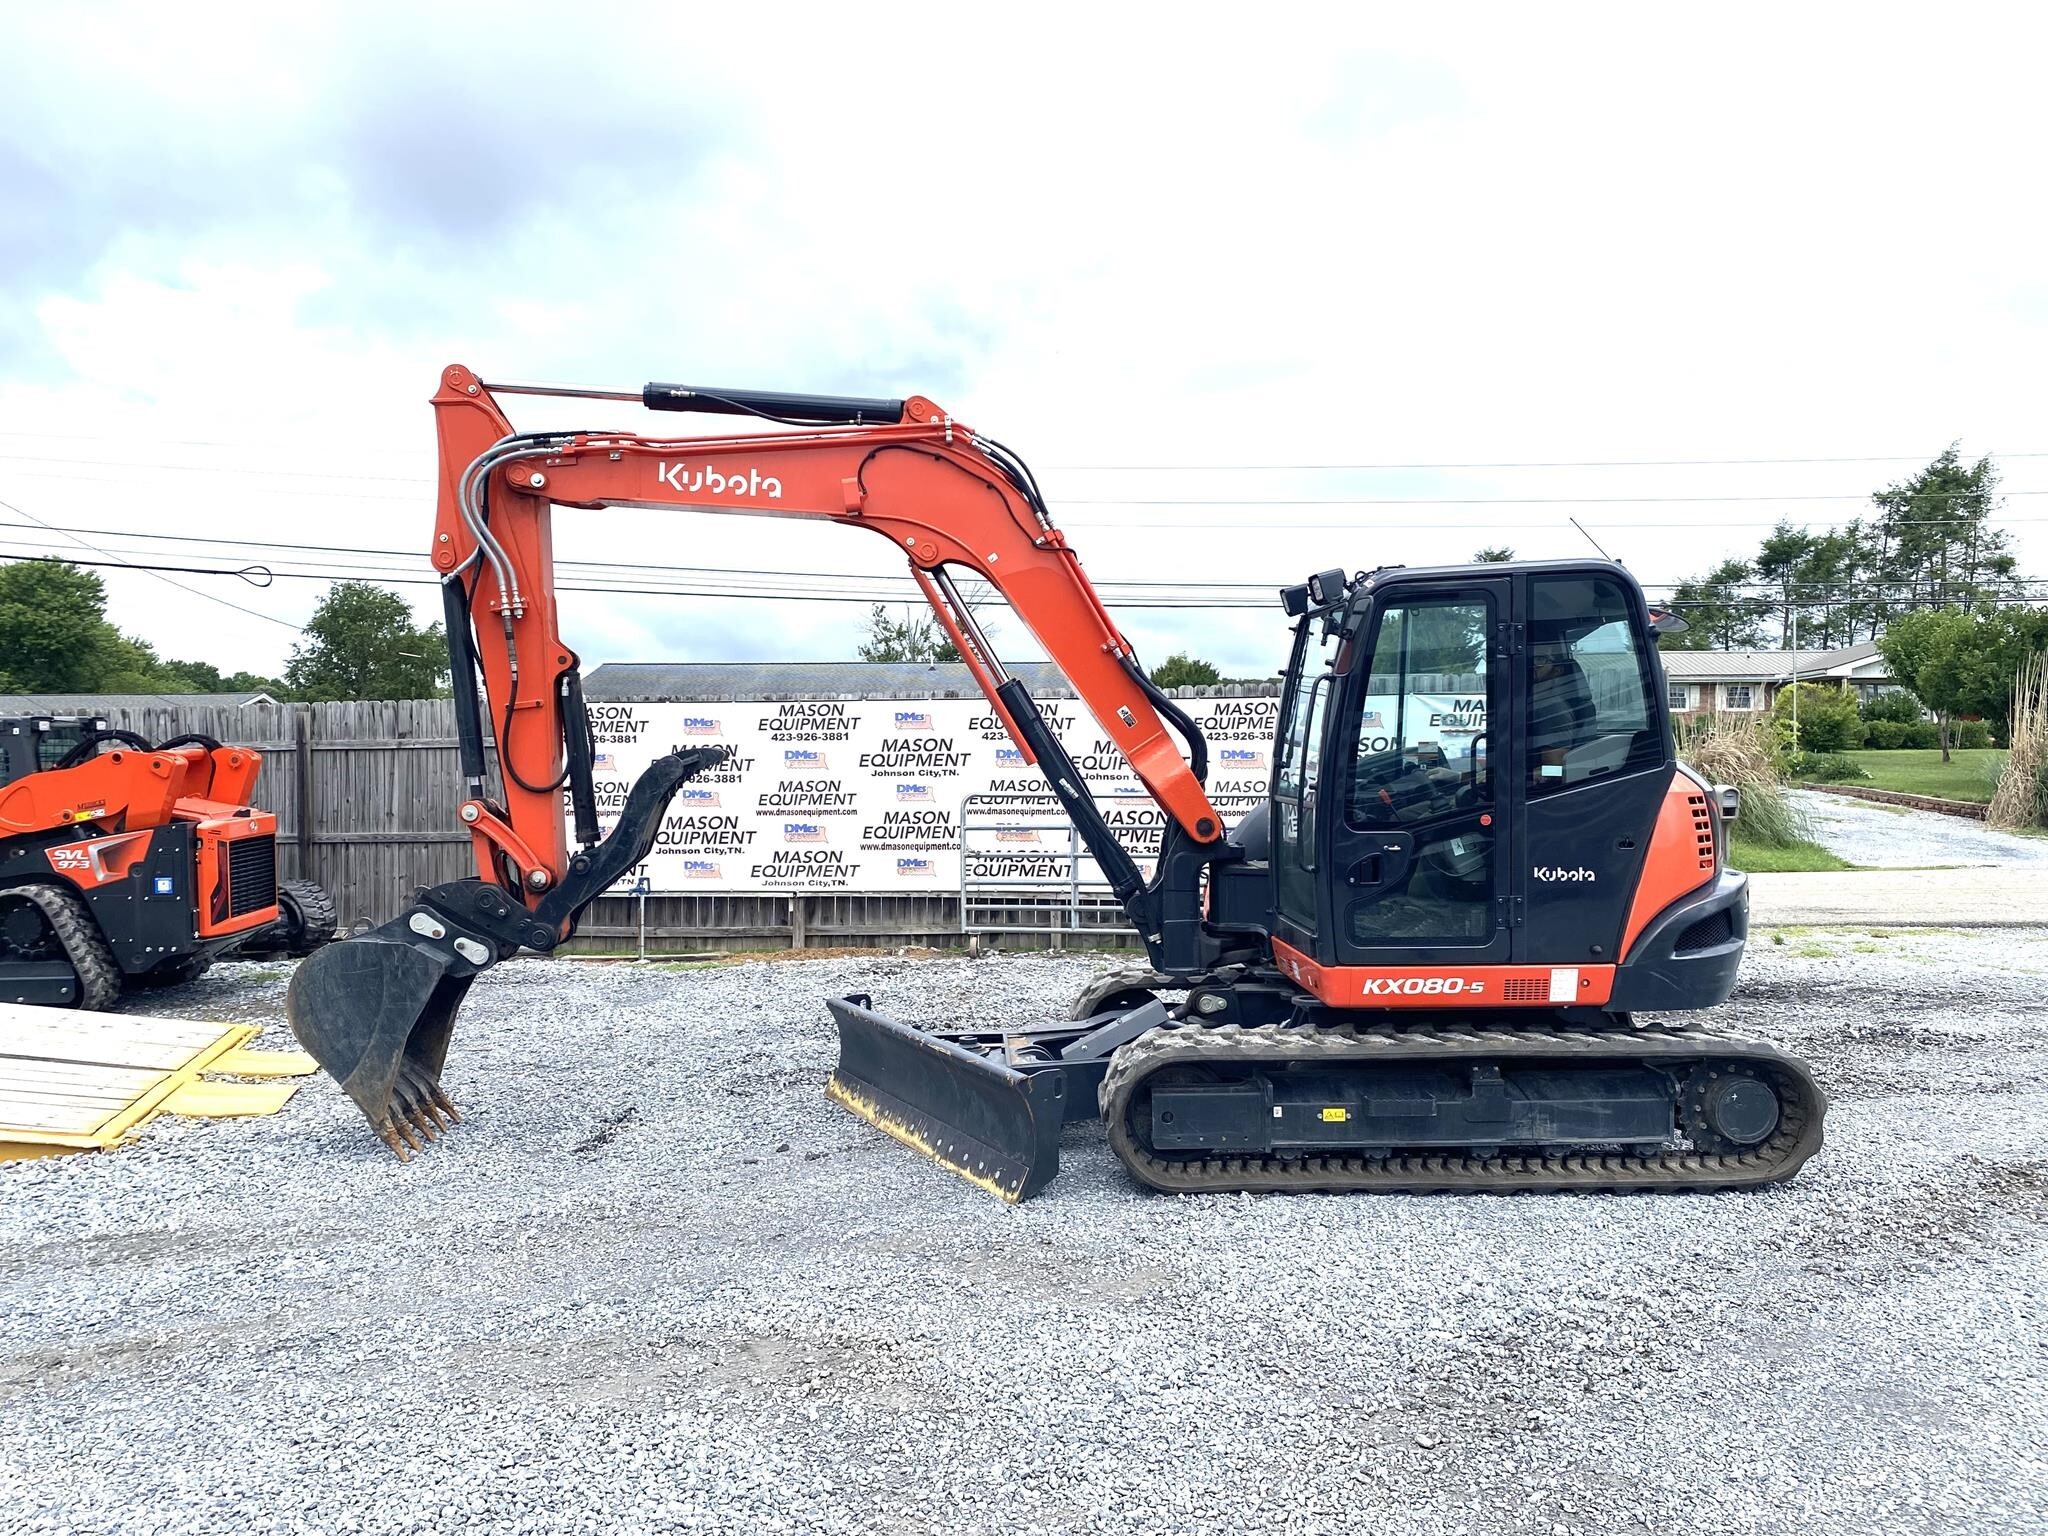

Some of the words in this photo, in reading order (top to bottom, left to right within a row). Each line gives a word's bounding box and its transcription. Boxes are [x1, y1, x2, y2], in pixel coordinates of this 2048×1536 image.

[658, 461, 782, 498] Kubota
[587, 707, 632, 719] ASON
[779, 703, 844, 717] MASON
[590, 720, 649, 733] PMENT
[758, 717, 861, 731] EQUIPMENT
[771, 732, 849, 741] 423-926-3881
[1206, 731, 1274, 741] 423-926-38
[881, 738, 953, 752] MASON
[859, 753, 971, 767] EQUIPMENT
[871, 769, 915, 777] Johnson
[918, 769, 960, 778] City,TN.
[1083, 773, 1129, 781] Johnson
[593, 782, 629, 793] SON
[778, 780, 841, 792] MASON
[1214, 781, 1266, 793] MASO
[758, 793, 857, 806] EQUIPMENT
[755, 808, 858, 818] www.dmasonequipment.com
[883, 811, 950, 825] MASON
[666, 816, 738, 830] MASON
[655, 831, 757, 845] QUIPMENT
[704, 847, 745, 856] City,TN.
[860, 842, 960, 852] www.dmasonequipment.co
[52, 849, 89, 860] SVL
[772, 851, 843, 864] MASON
[57, 860, 90, 869] 97-3
[750, 865, 861, 878] EQUIPMENT
[1533, 866, 1595, 881] Kubota
[1362, 978, 1485, 995] KX080-5
